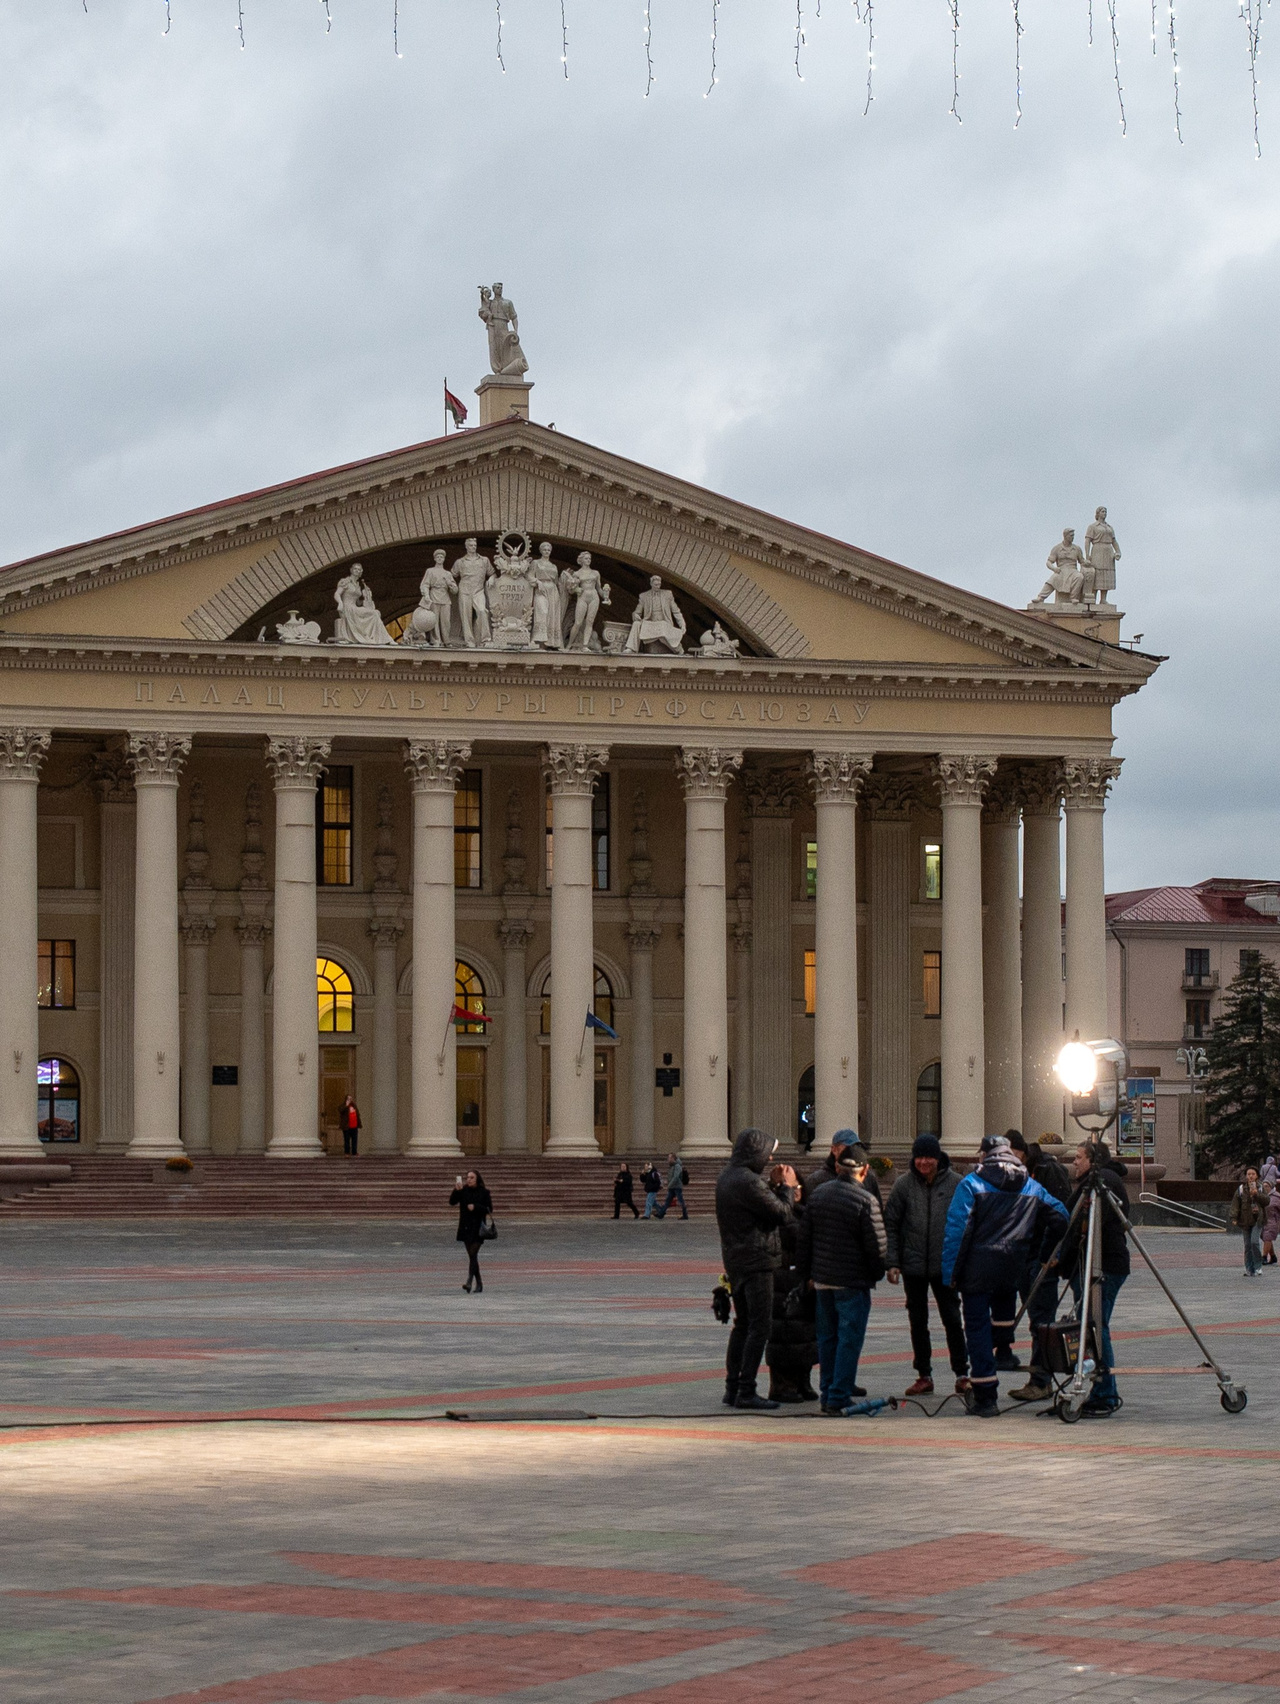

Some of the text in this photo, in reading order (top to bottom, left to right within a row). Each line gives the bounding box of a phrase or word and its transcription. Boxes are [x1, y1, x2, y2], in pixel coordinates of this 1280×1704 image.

[135, 682, 872, 724] ПАЛАЦ КУЛЬТУРЫ ПРАФСАЮЗАЎ
